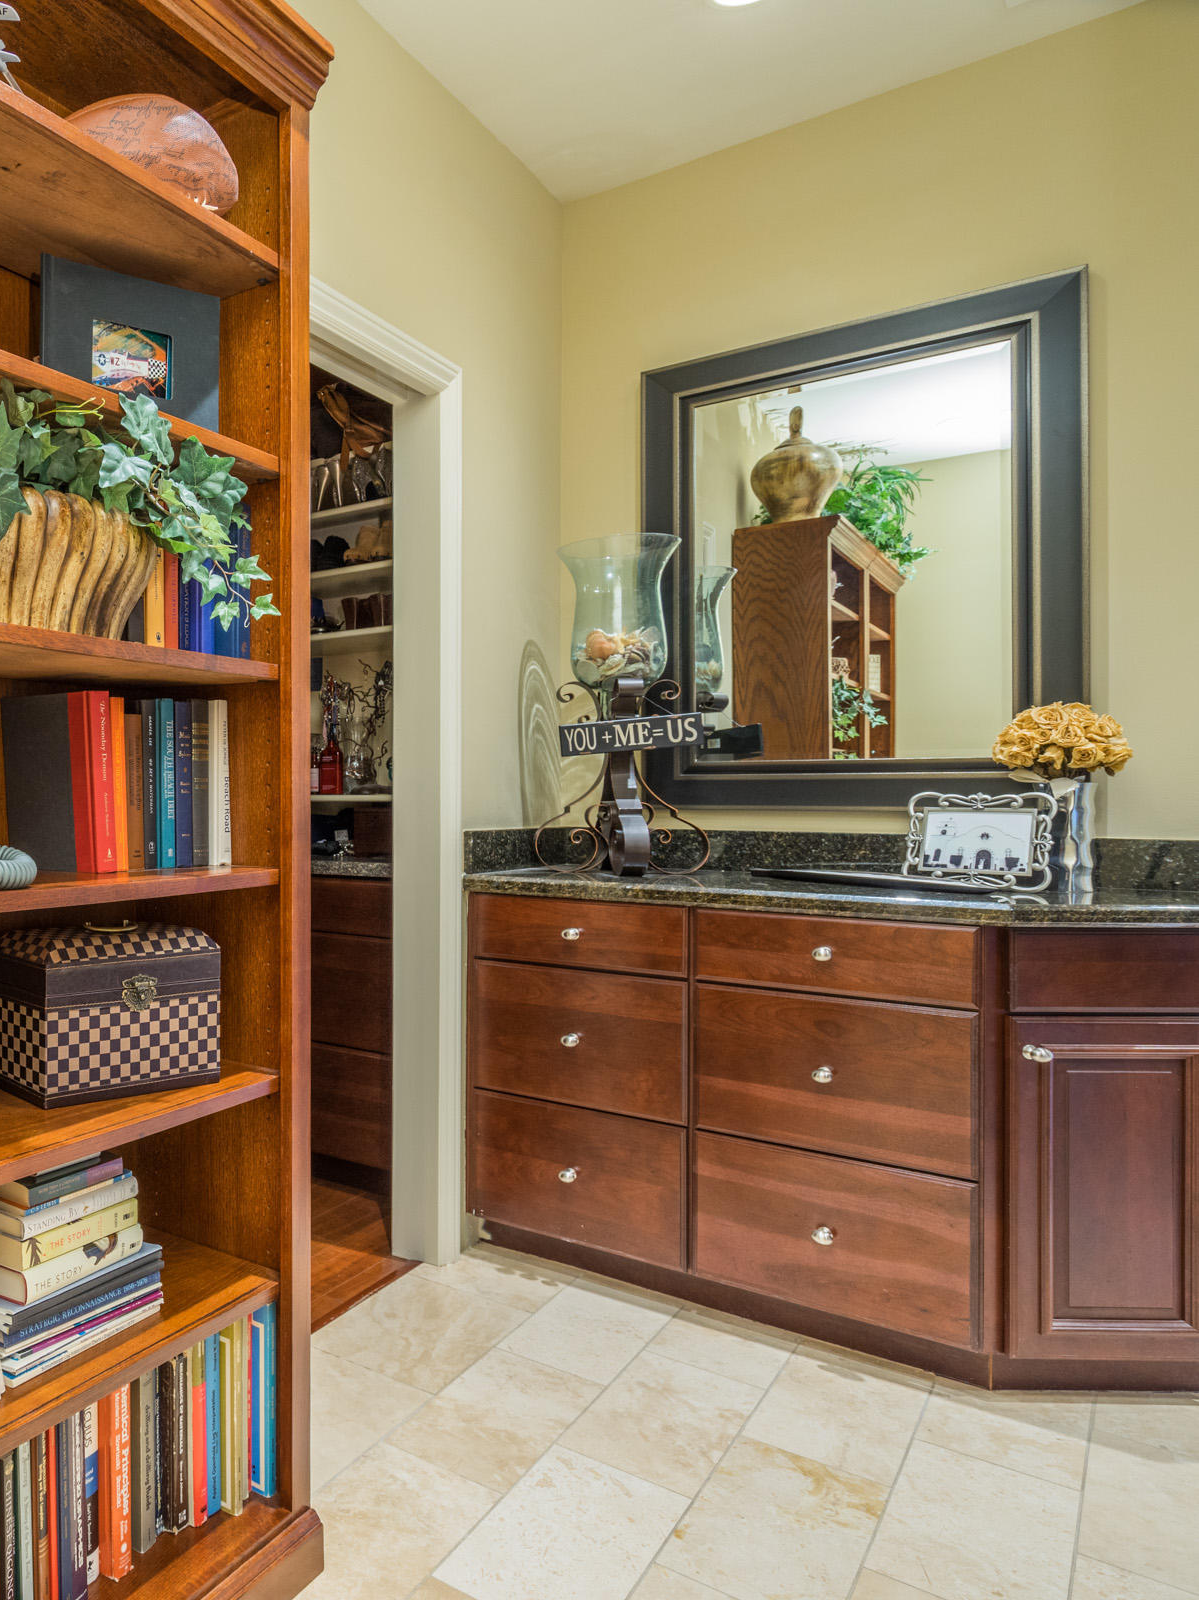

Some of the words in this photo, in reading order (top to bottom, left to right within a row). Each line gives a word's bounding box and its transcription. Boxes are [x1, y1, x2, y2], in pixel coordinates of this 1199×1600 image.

[564, 726, 598, 753] YOU
[668, 716, 698, 743] US
[27, 1214, 66, 1232] STANDING
[49, 1238, 64, 1250] THE
[67, 1227, 92, 1243] STORY
[34, 1281, 52, 1293] THE
[55, 1264, 84, 1284] STORY
[19, 1313, 61, 1338] STRATEGIC
[61, 1287, 122, 1320] RECONNAISSANCE
[121, 1447, 131, 1516] Principles
[4, 1479, 13, 1540] CHINESE
